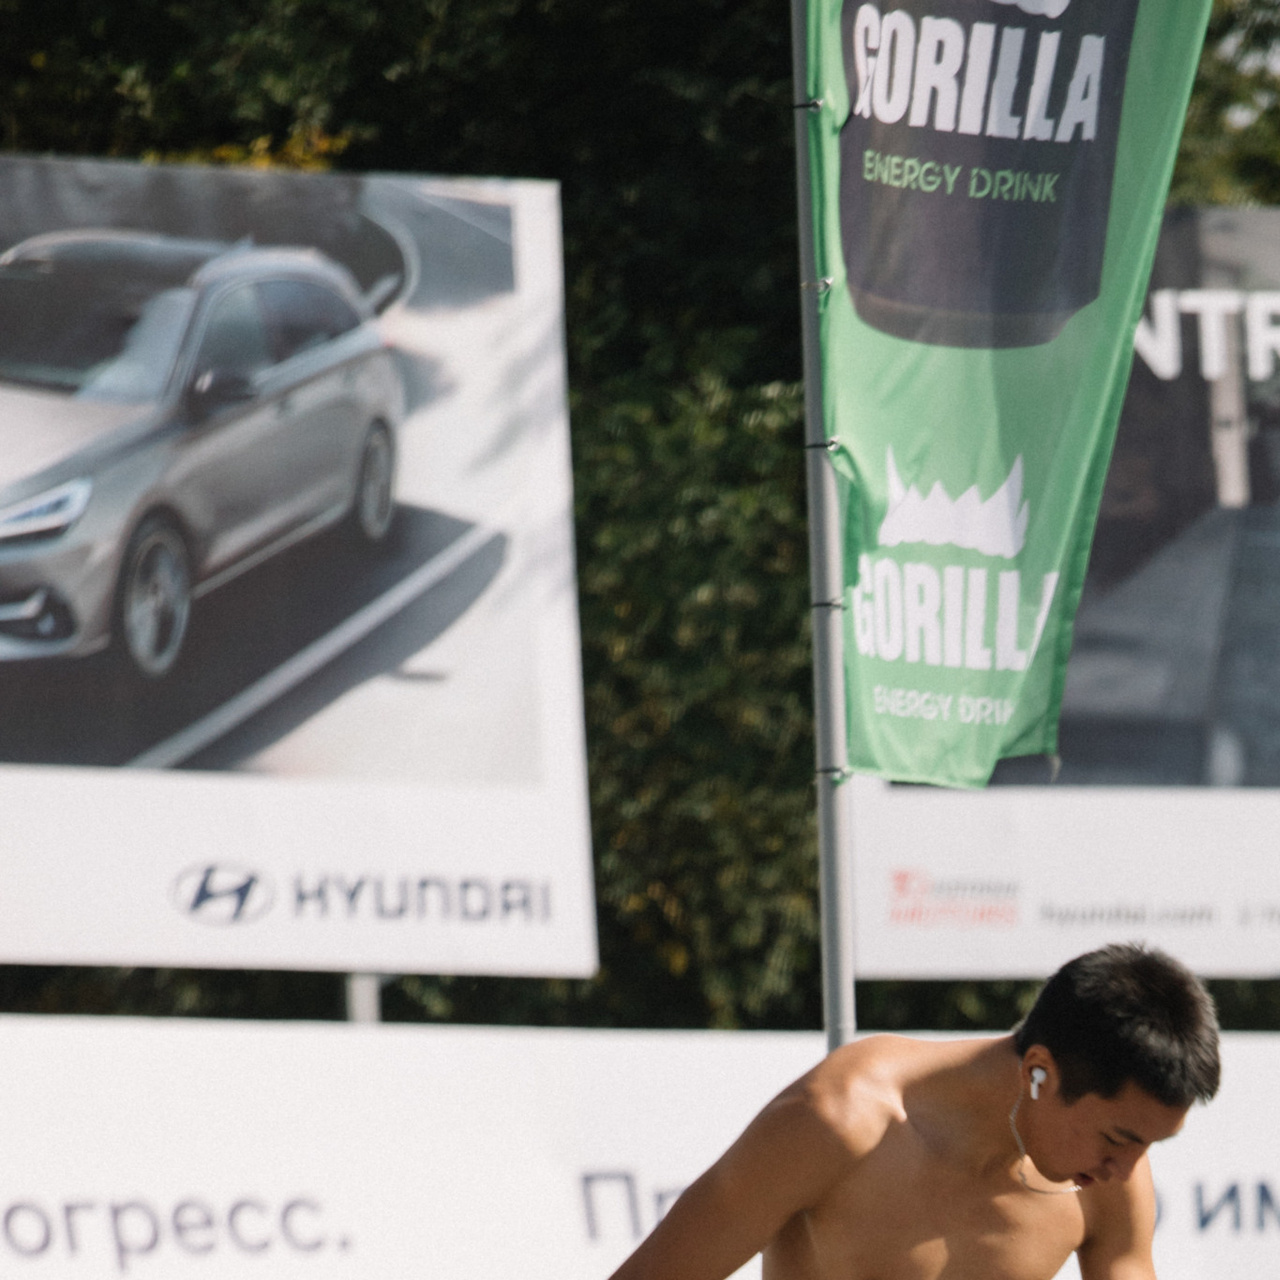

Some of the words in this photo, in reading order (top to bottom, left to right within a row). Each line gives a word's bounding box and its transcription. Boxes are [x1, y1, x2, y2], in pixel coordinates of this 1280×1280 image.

[853, 3, 1105, 142] GORILLA
[863, 150, 961, 195] ENERGY
[968, 168, 1061, 202] DRINK
[293, 875, 553, 923] HYUNDAI
[0, 1196, 352, 1273] огресс.
